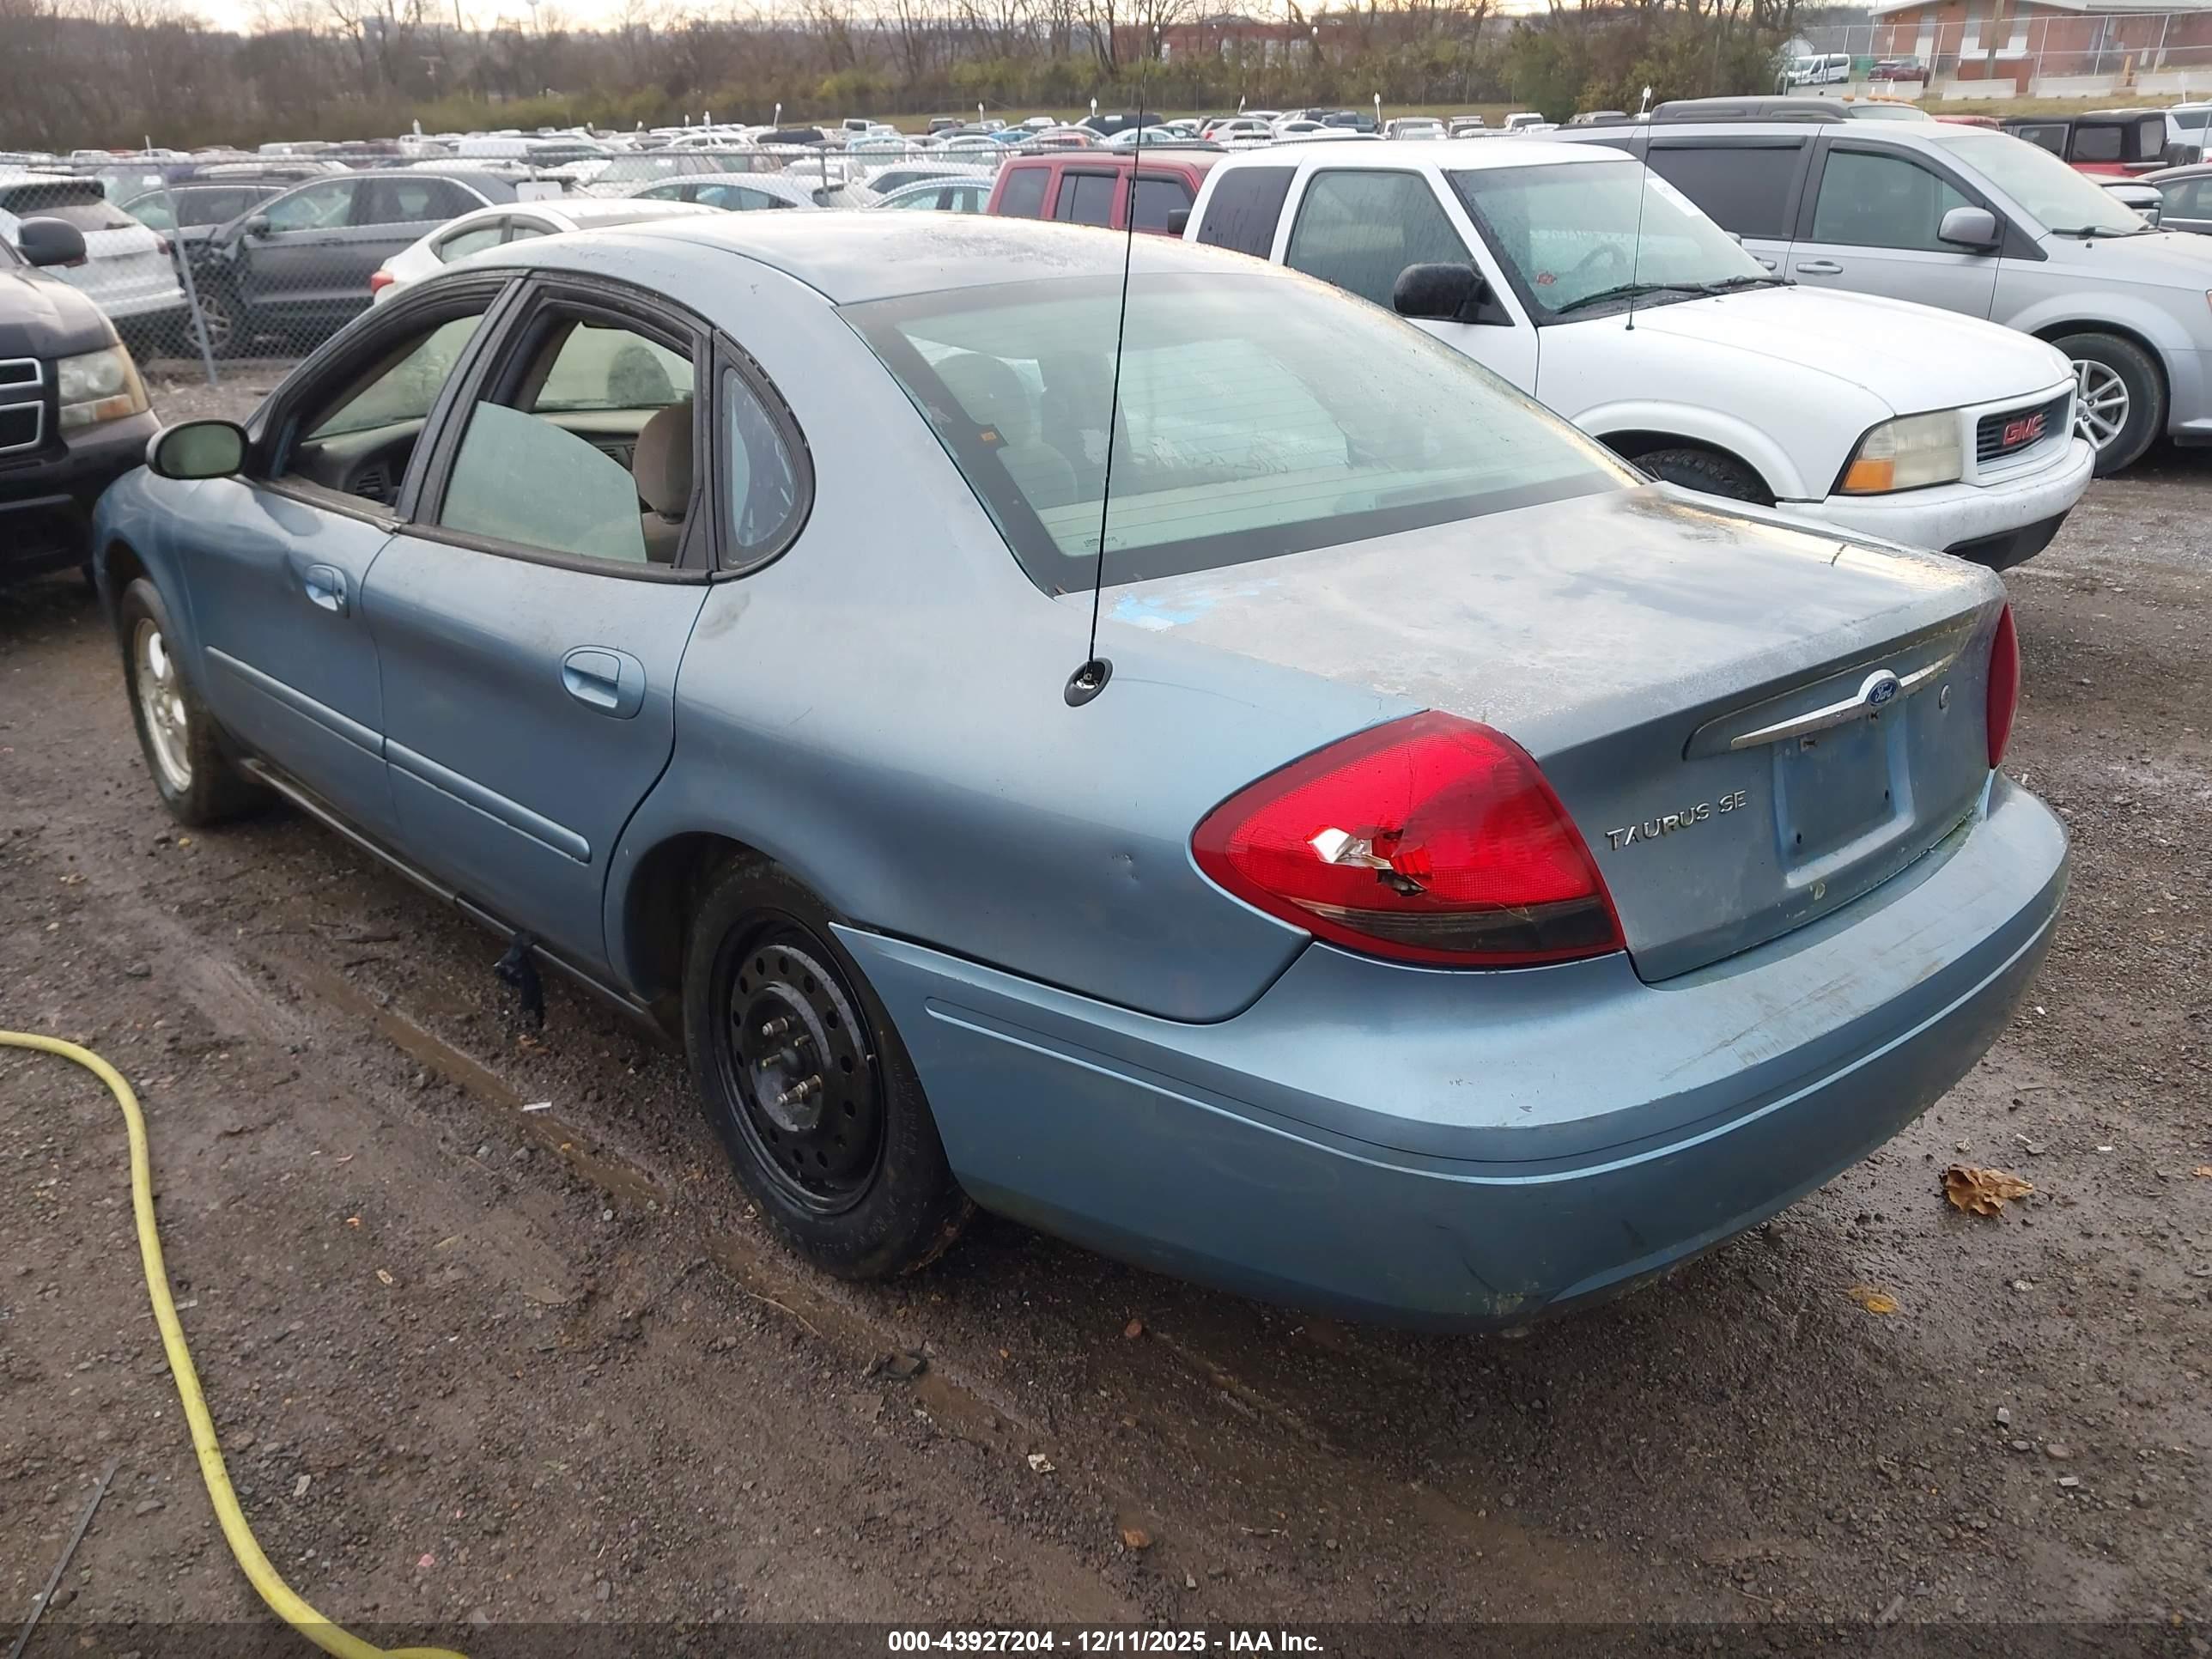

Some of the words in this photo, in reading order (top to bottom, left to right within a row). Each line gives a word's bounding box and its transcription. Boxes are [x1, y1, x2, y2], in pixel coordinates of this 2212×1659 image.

[2003, 412, 2043, 445] GMC
[1875, 683, 1893, 702] Ford
[1605, 803, 1710, 850] TAURUS
[1718, 789, 1747, 814] SE
